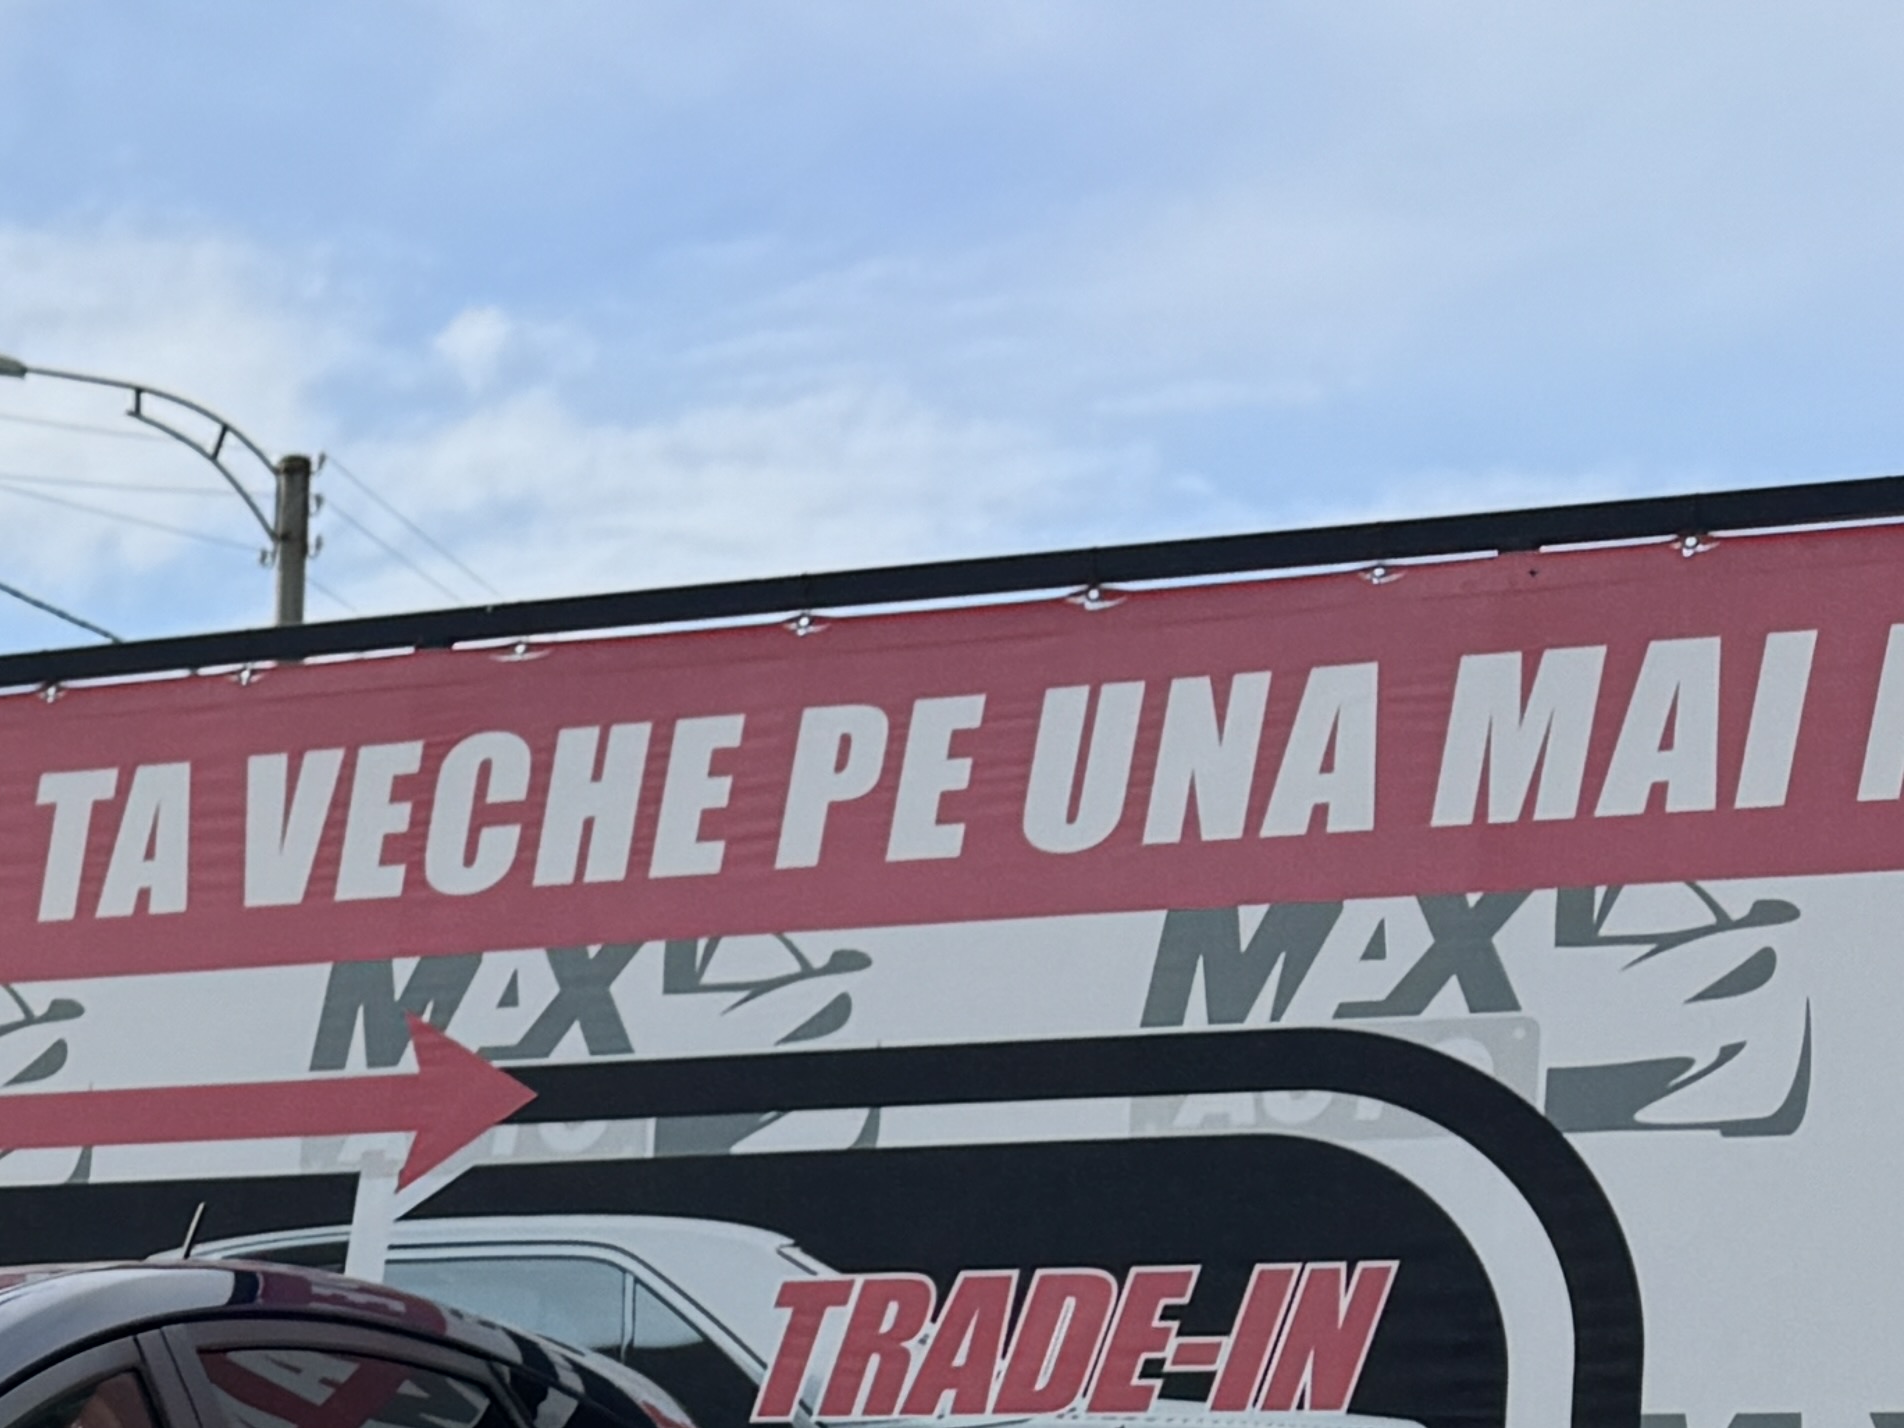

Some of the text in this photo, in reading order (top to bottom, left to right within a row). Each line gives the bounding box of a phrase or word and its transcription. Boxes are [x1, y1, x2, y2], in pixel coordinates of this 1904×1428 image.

[35, 761, 191, 923] TA
[244, 713, 746, 908] VECHE
[774, 693, 987, 870] PE
[1022, 661, 1379, 854] UNA
[1430, 629, 1818, 828] MAI
[1140, 889, 1540, 1028] MAX
[749, 1259, 1399, 1424] TRADE-IN
